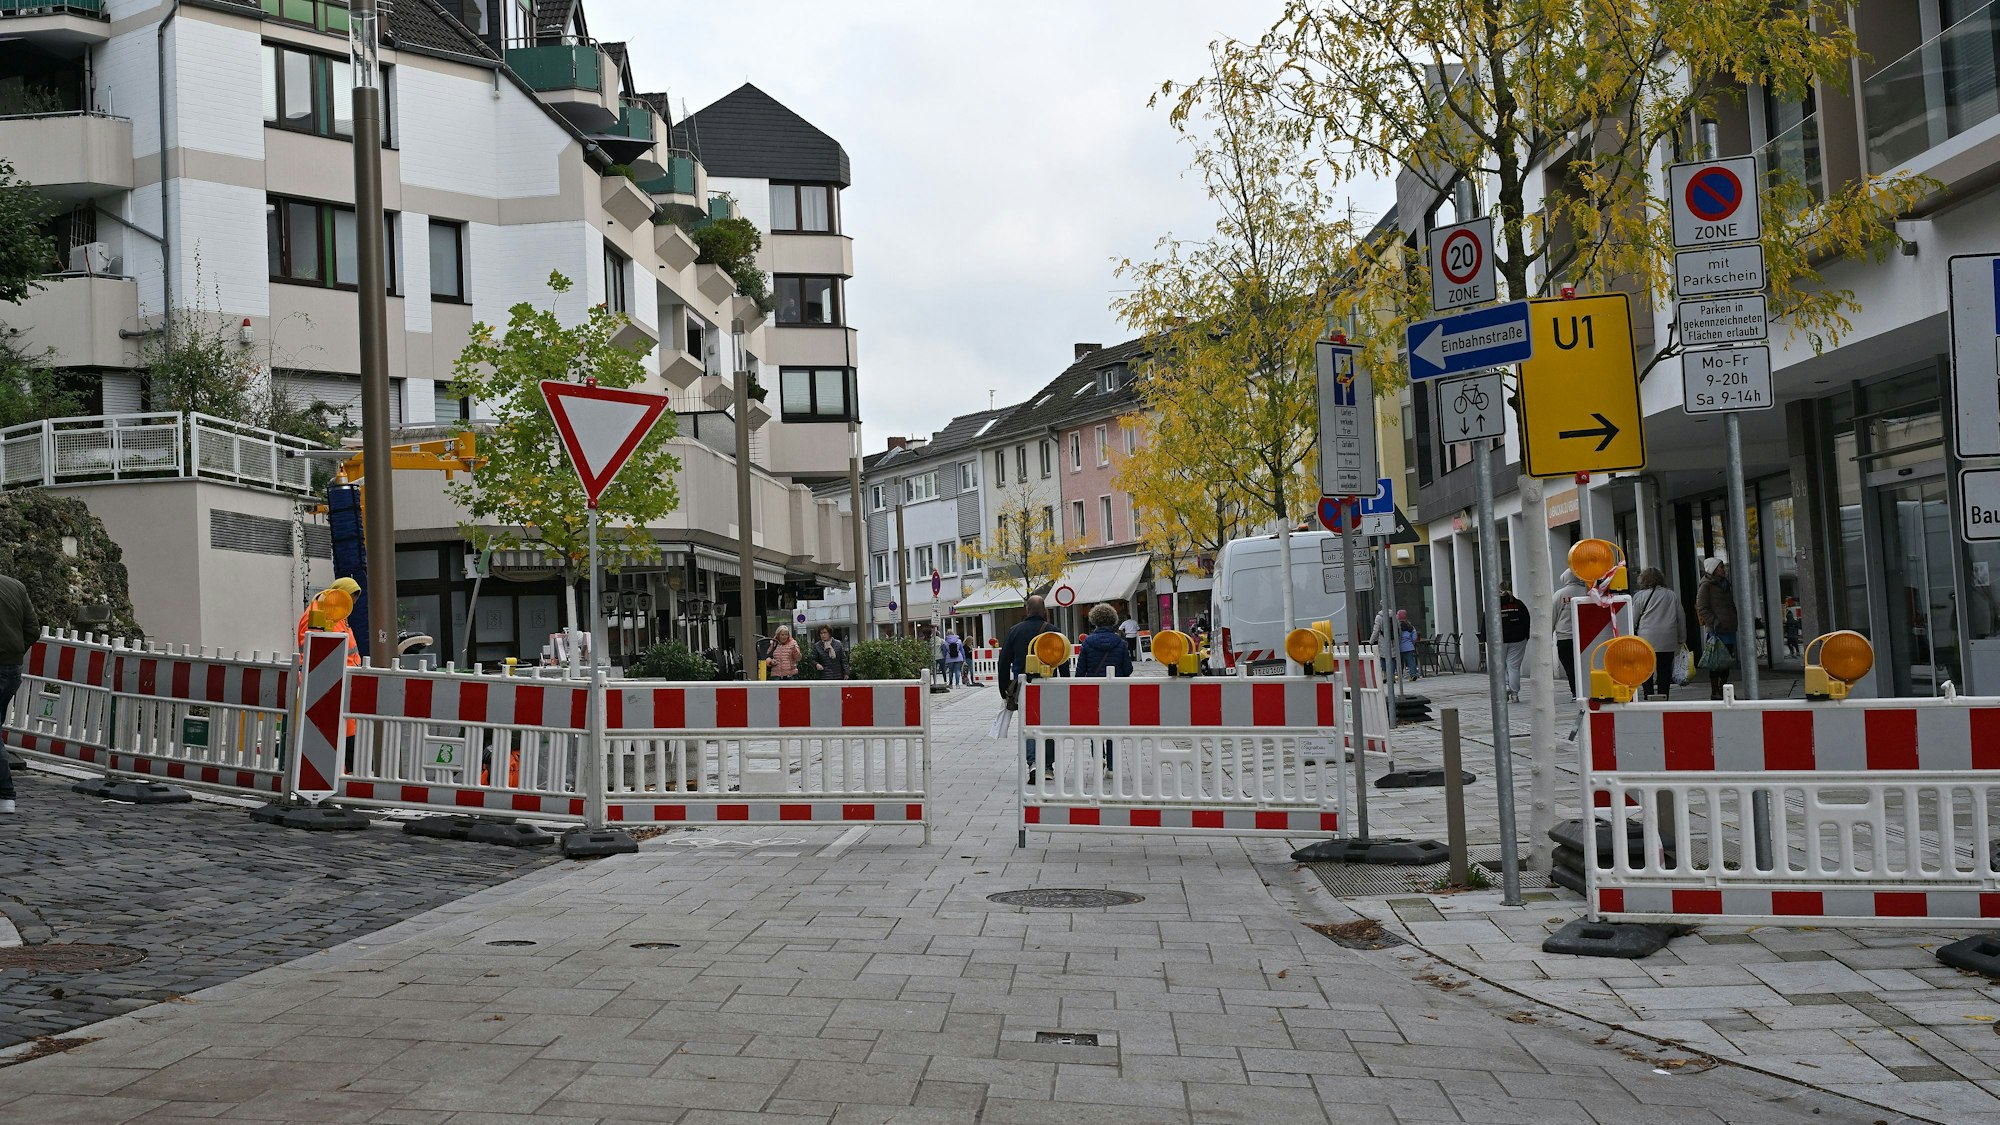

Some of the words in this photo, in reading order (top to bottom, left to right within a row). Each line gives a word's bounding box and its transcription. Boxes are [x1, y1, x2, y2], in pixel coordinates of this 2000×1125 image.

[1695, 223, 1738, 240] ZONE
[1450, 243, 1474, 271] 20
[1708, 257, 1730, 270] mit
[1683, 270, 1757, 287] Parkschein
[1449, 285, 1480, 303] ZONE
[1700, 304, 1731, 315] Parken
[1735, 302, 1744, 312] in
[1683, 314, 1763, 331] gekennzeichneten
[1441, 326, 1523, 353] Einbahnstraße
[1552, 314, 1594, 350] U1
[1688, 330, 1723, 341] Flächen
[1726, 326, 1759, 338] erlaubt
[1702, 354, 1749, 369] Mo-Fr
[1706, 372, 1748, 387] 9-20h
[1696, 393, 1714, 406] Sa
[1721, 390, 1761, 404] 9-14h
[1395, 569, 1413, 584] 20
